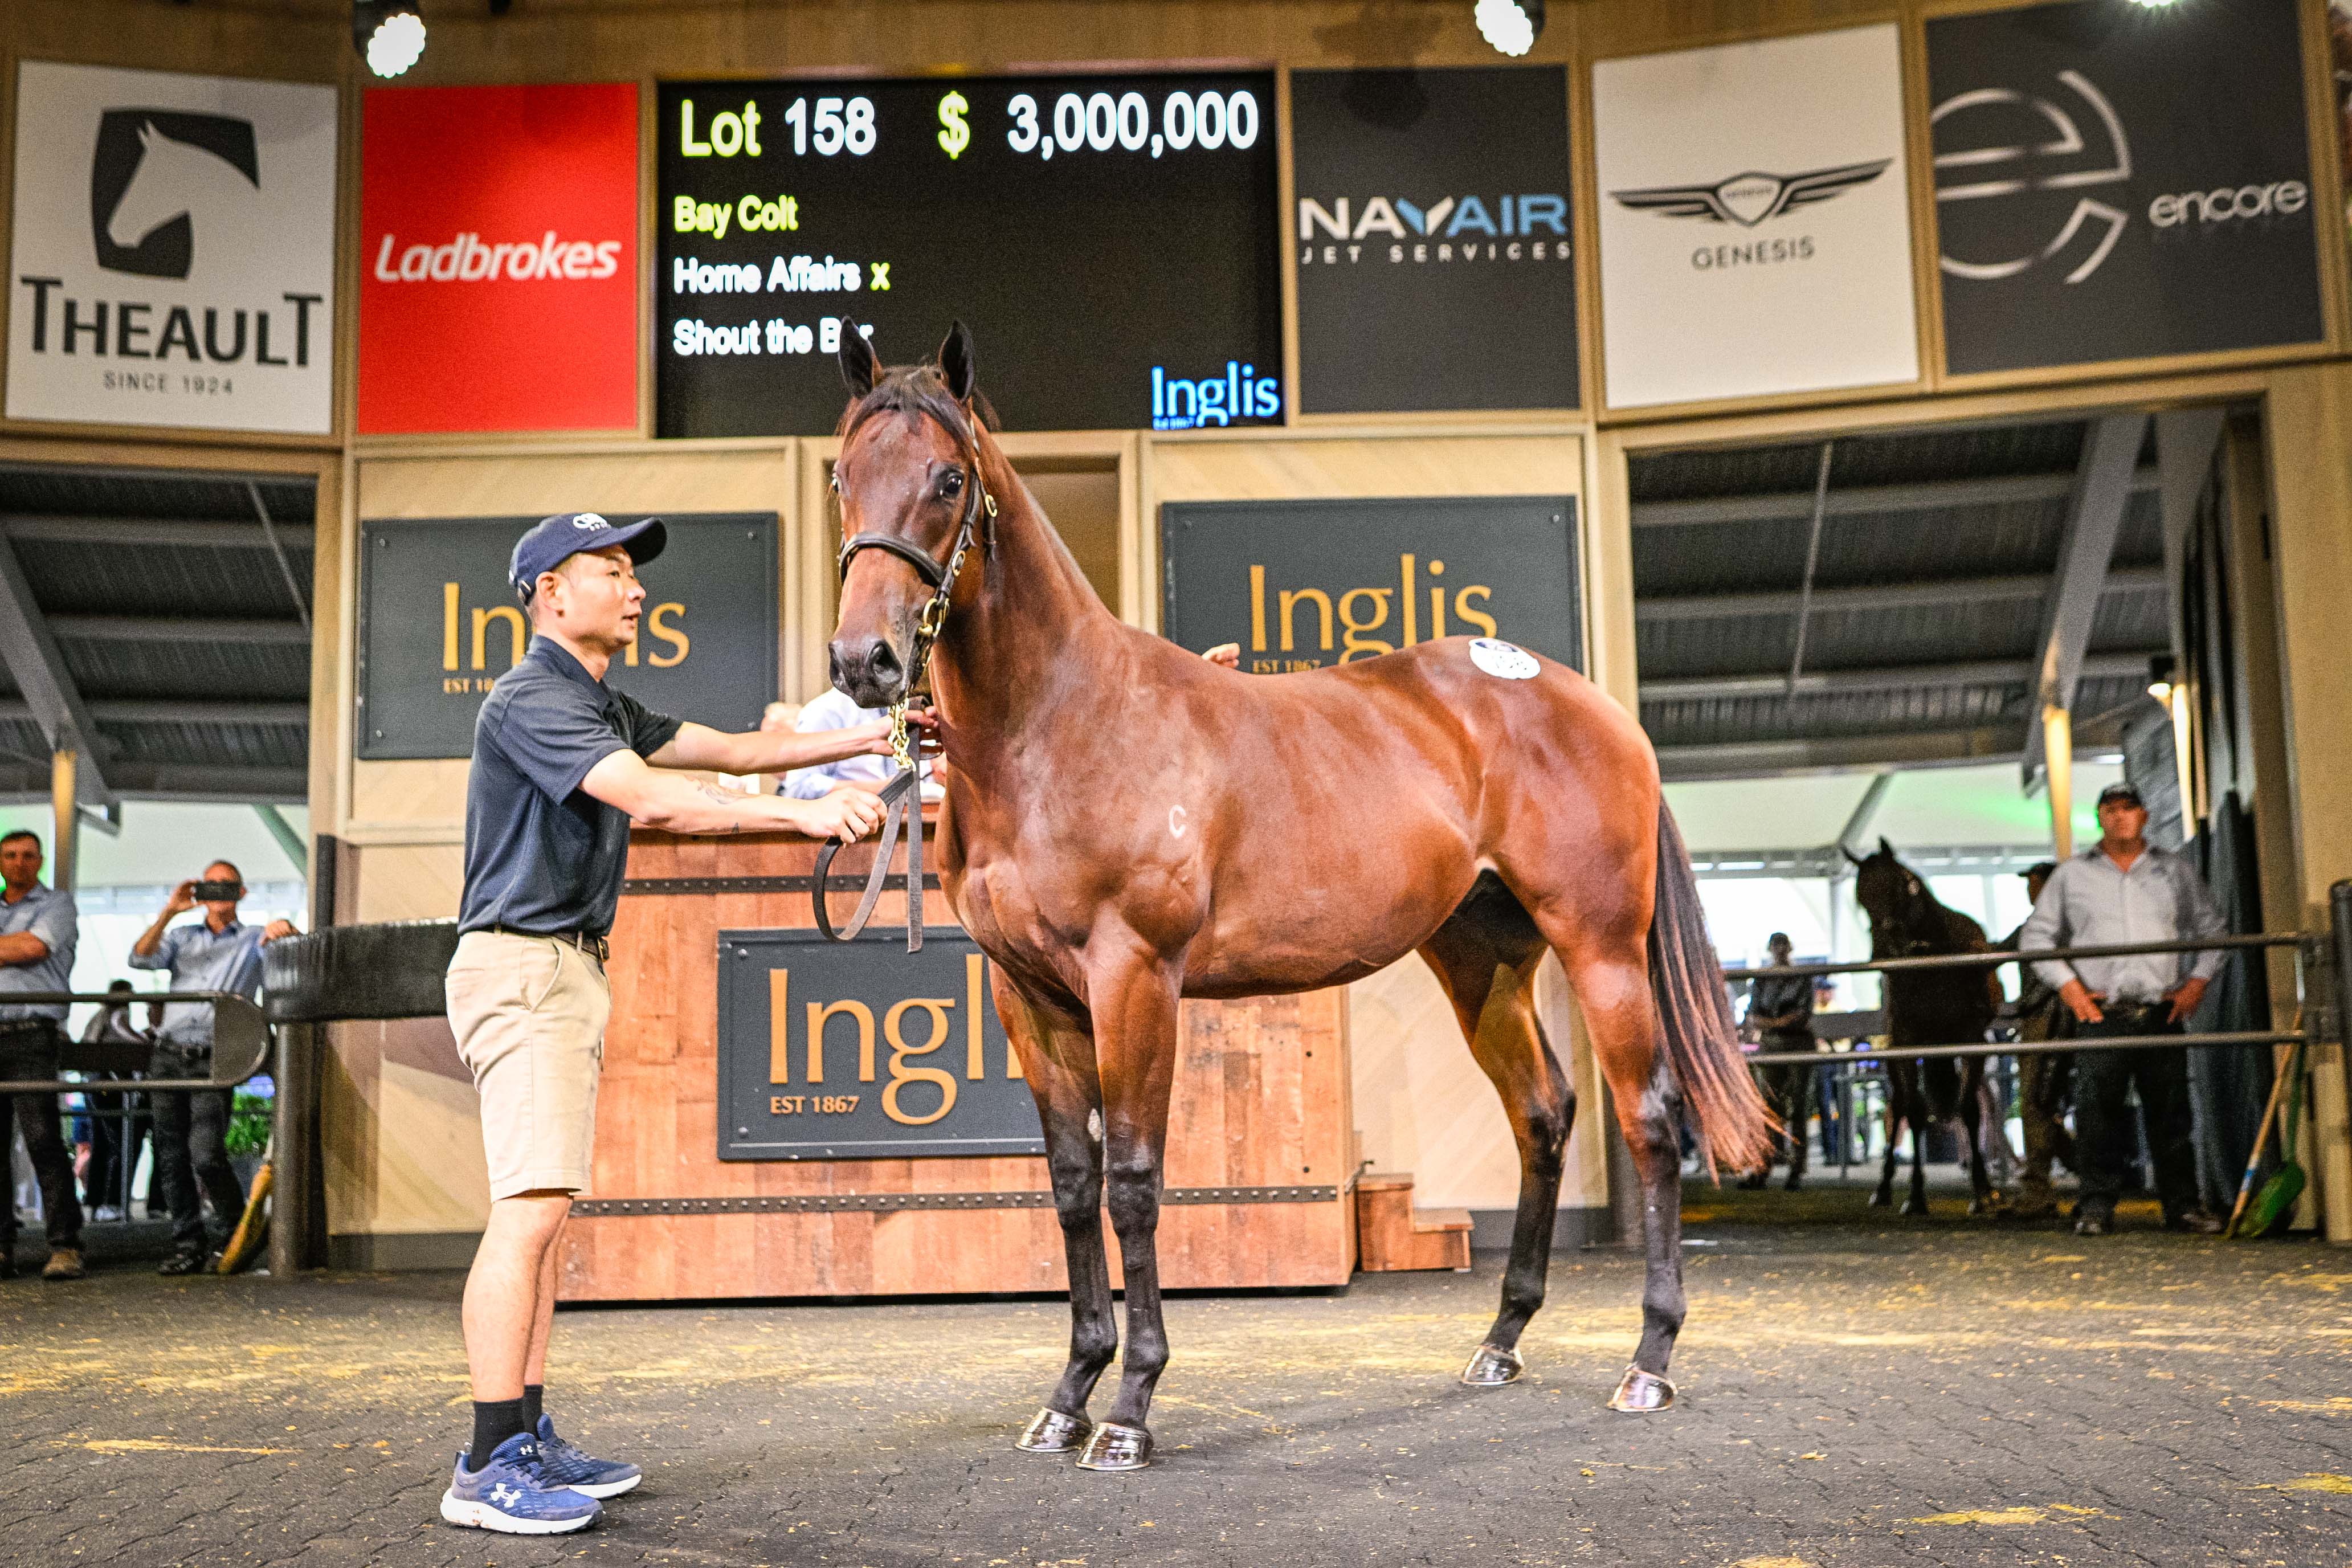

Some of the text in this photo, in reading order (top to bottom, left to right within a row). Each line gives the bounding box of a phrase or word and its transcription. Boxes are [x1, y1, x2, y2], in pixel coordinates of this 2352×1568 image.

[681, 89, 1259, 161] Lot 158 $ 3,000,000
[673, 194, 799, 240] Bay Colt
[1299, 195, 1568, 240] NAVAIR
[2147, 179, 2309, 228] encore
[374, 230, 622, 283] Ladbrokes
[673, 255, 891, 295] Home Affairs x
[1301, 240, 1571, 265] JET SERVICES
[1690, 235, 1816, 271] GENESIS
[21, 276, 324, 368] THEAULT
[672, 316, 874, 357] Shout the Br
[103, 369, 233, 395] SINCE 1924
[1151, 360, 1280, 427] Inglis
[443, 582, 690, 671] Ins
[1250, 553, 1497, 665] Inglis
[770, 954, 1024, 1125] Ingl
[770, 1096, 860, 1114] EST 1867
